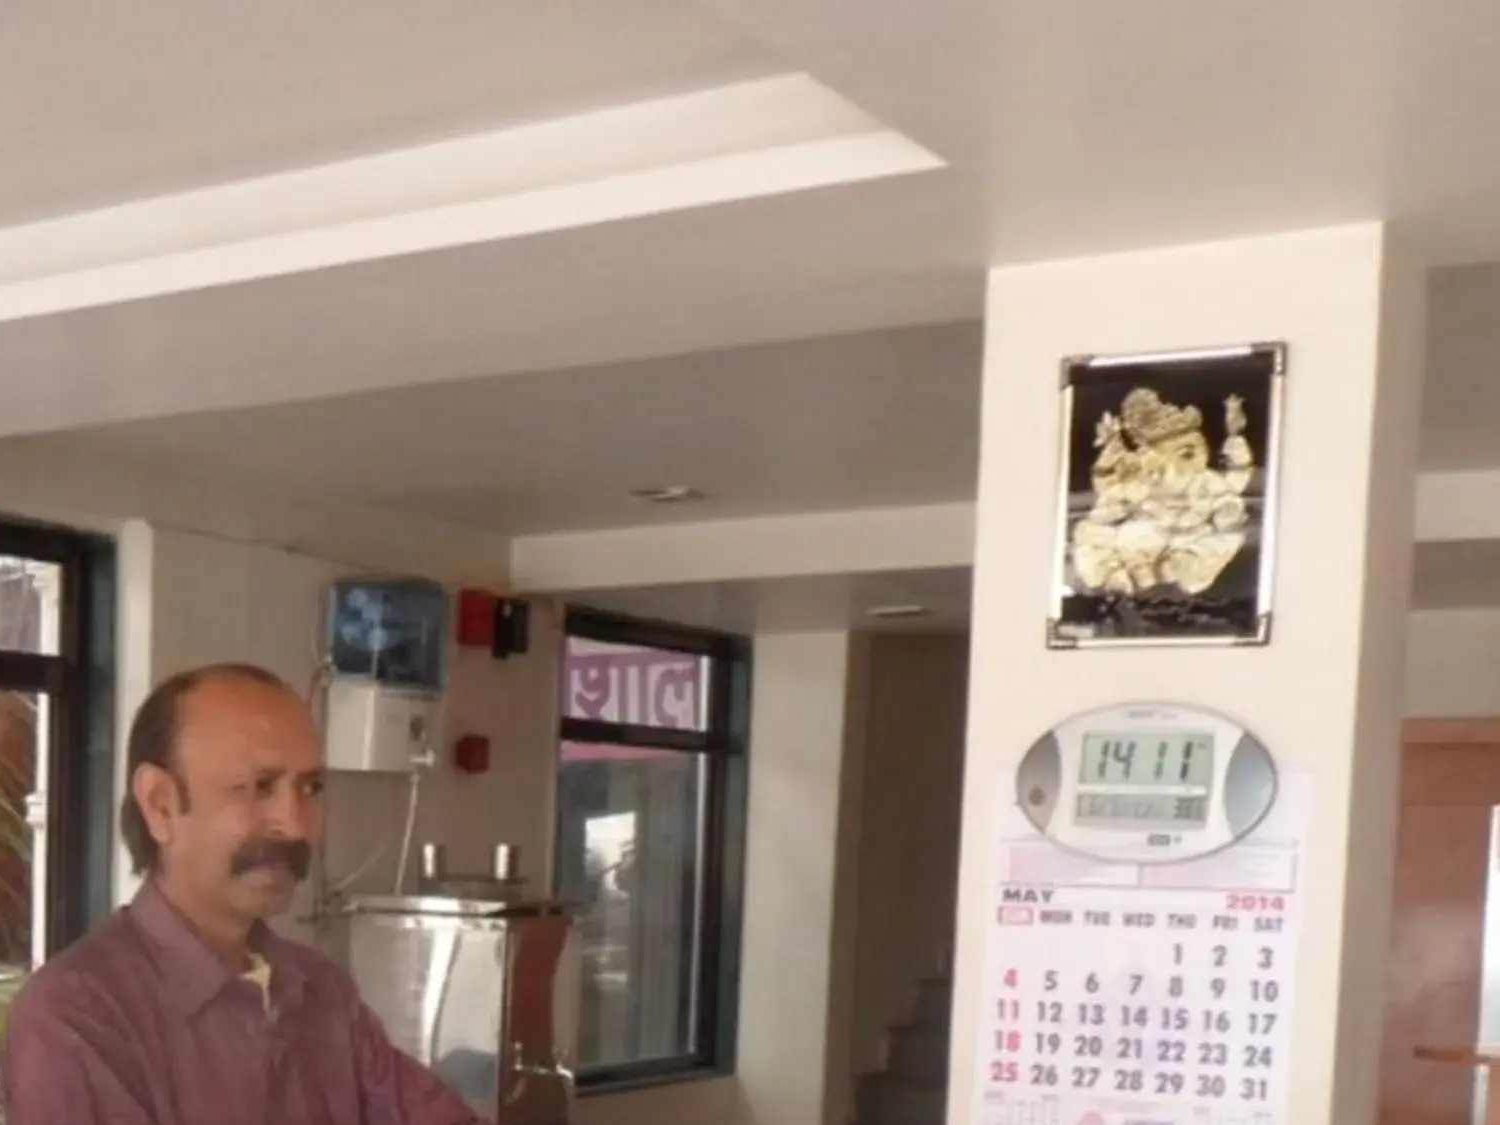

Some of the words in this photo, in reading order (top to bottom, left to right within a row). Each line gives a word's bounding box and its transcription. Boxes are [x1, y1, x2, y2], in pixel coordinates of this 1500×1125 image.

[1002, 888, 1054, 904] MAY
[1225, 894, 1286, 912] 2014
[1253, 915, 1285, 933] SAT
[1173, 943, 1184, 965] 1
[1212, 945, 1228, 967] 2
[1257, 947, 1274, 970] 3
[1003, 969, 1018, 988] 4
[1043, 970, 1059, 991] 5
[1084, 972, 1100, 994] 6
[1129, 974, 1144, 995] 7
[1167, 976, 1184, 998] 8
[1209, 978, 1226, 998] 9
[1250, 979, 1279, 1003] 10
[996, 998, 1020, 1022] 11
[1036, 1000, 1064, 1024] 12
[1078, 1003, 1106, 1026] 13
[1121, 1005, 1148, 1028] 14
[1161, 1007, 1189, 1031] 15
[1203, 1009, 1231, 1034] 16
[1248, 1012, 1278, 1035] 17
[995, 1029, 1022, 1053] 18
[1035, 1031, 1062, 1055] 19
[1074, 1034, 1104, 1058] 20
[1116, 1036, 1143, 1060] 21
[1156, 1039, 1187, 1063] 22
[1198, 1041, 1228, 1067] 23
[1243, 1044, 1273, 1068] 24
[991, 1060, 1019, 1083] 25
[1030, 1062, 1059, 1087] 26
[1071, 1065, 1102, 1089] 27
[1114, 1068, 1144, 1092] 28
[1154, 1071, 1185, 1095] 29
[1195, 1073, 1227, 1098] 30
[1239, 1077, 1268, 1102] 31
